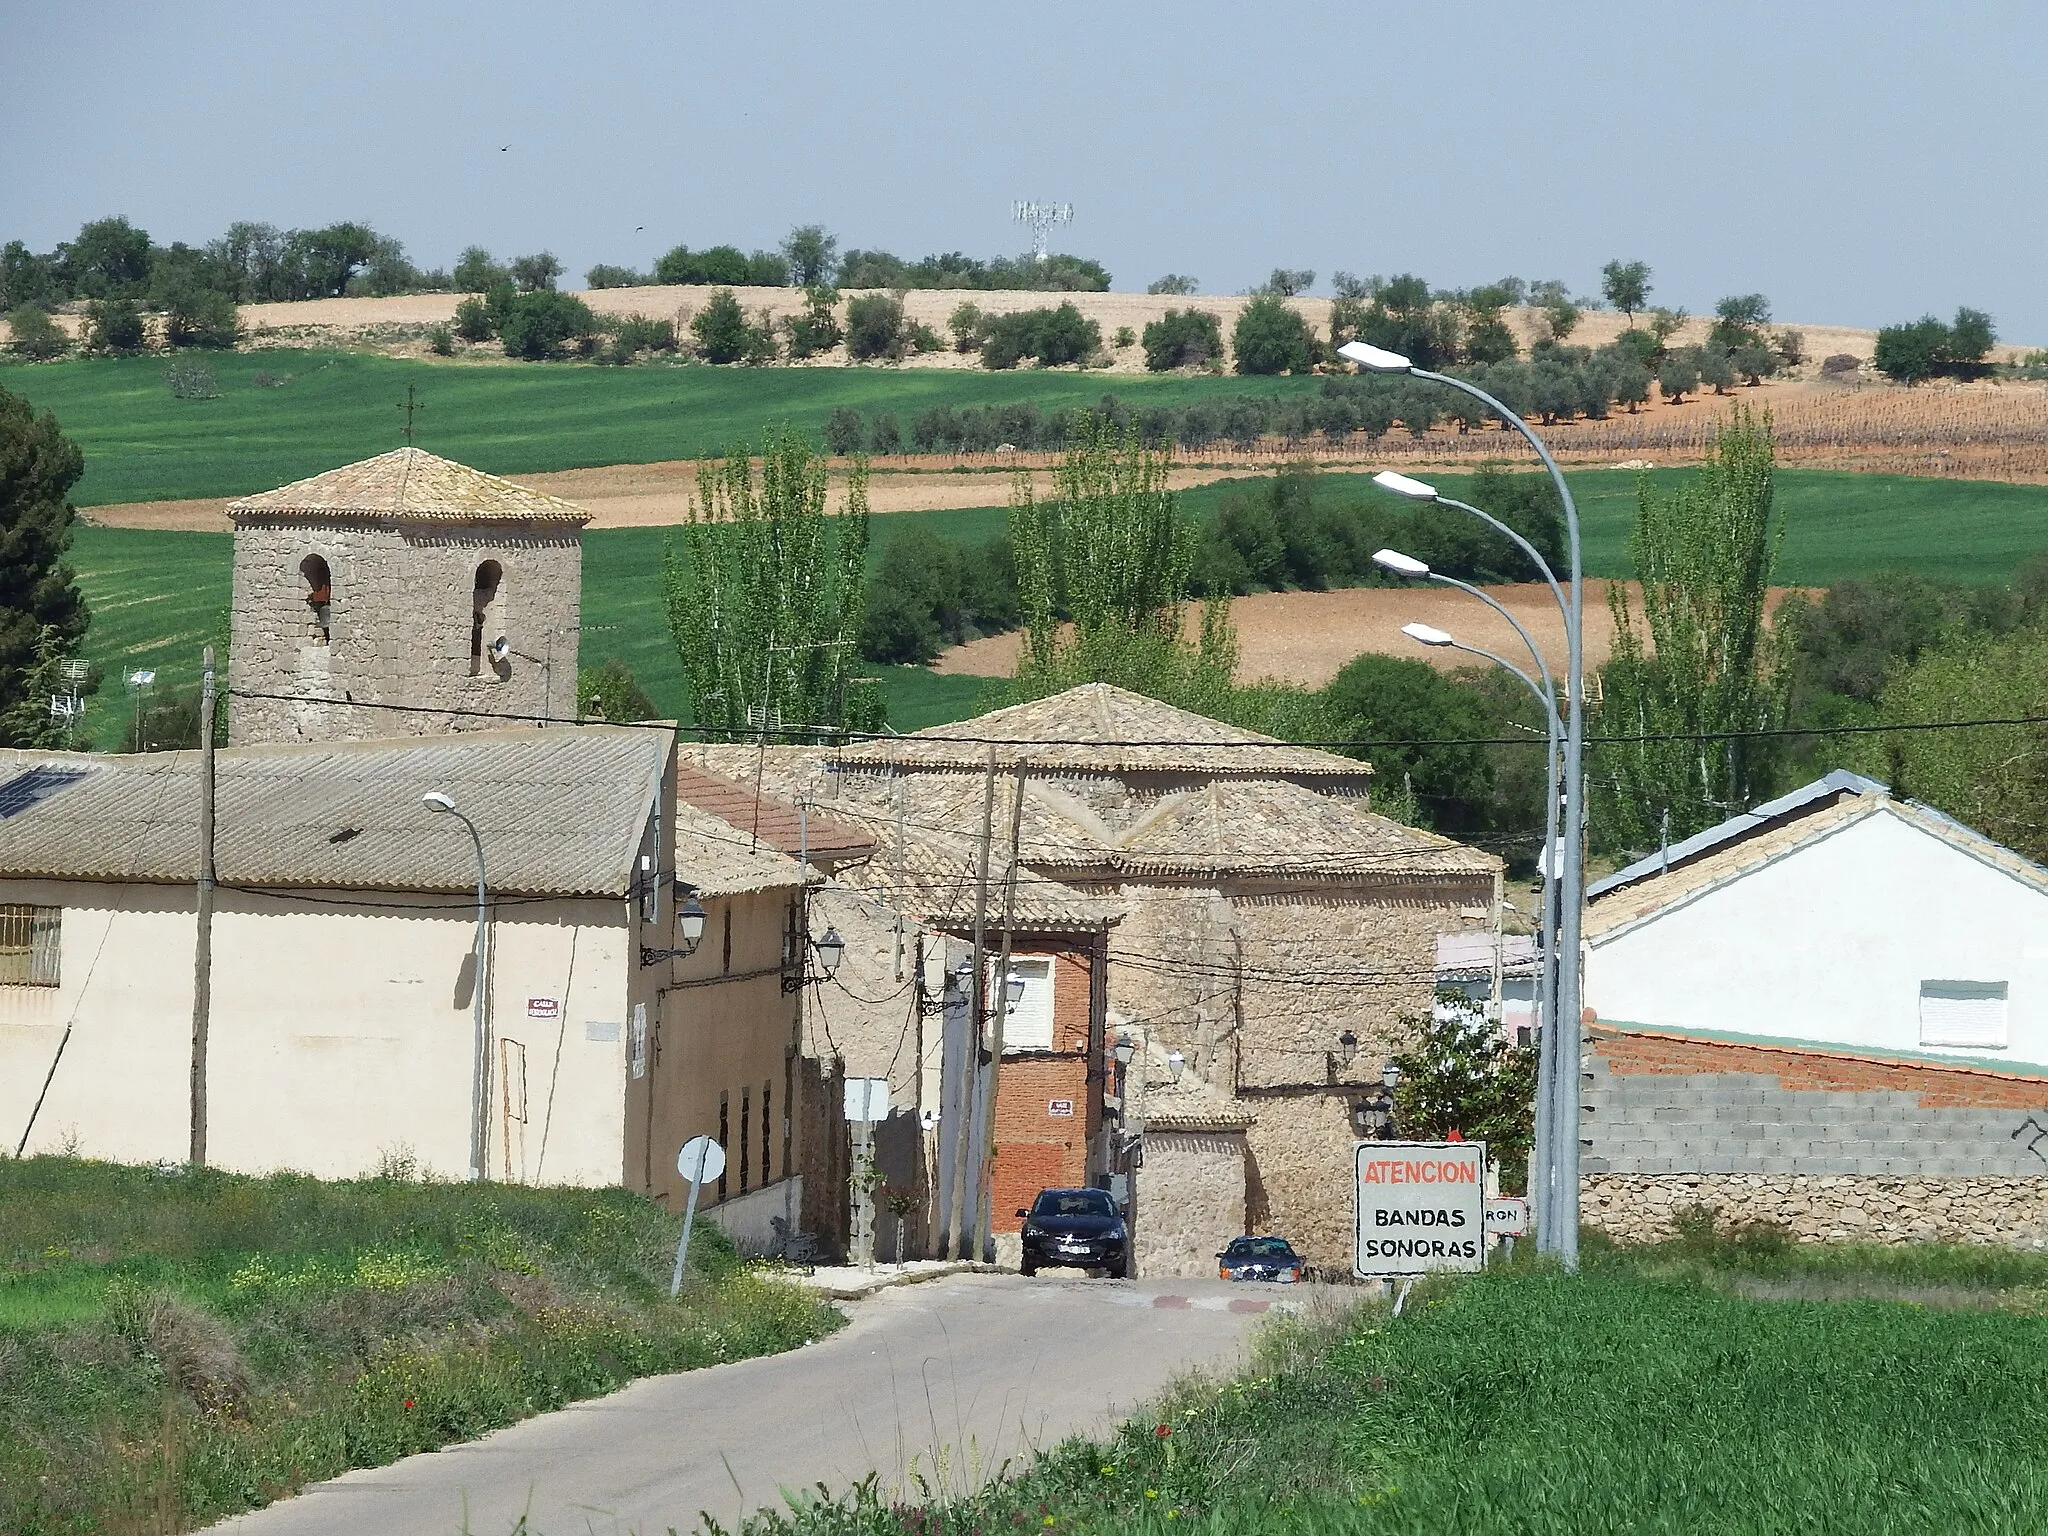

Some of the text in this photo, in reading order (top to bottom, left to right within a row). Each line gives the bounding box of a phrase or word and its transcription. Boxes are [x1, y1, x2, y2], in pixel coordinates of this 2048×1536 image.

[1364, 1161, 1476, 1184] ATENCION
[1375, 1209, 1466, 1228] BANDAS
[1486, 1210, 1517, 1222] RON
[1366, 1239, 1477, 1259] SONORAS
